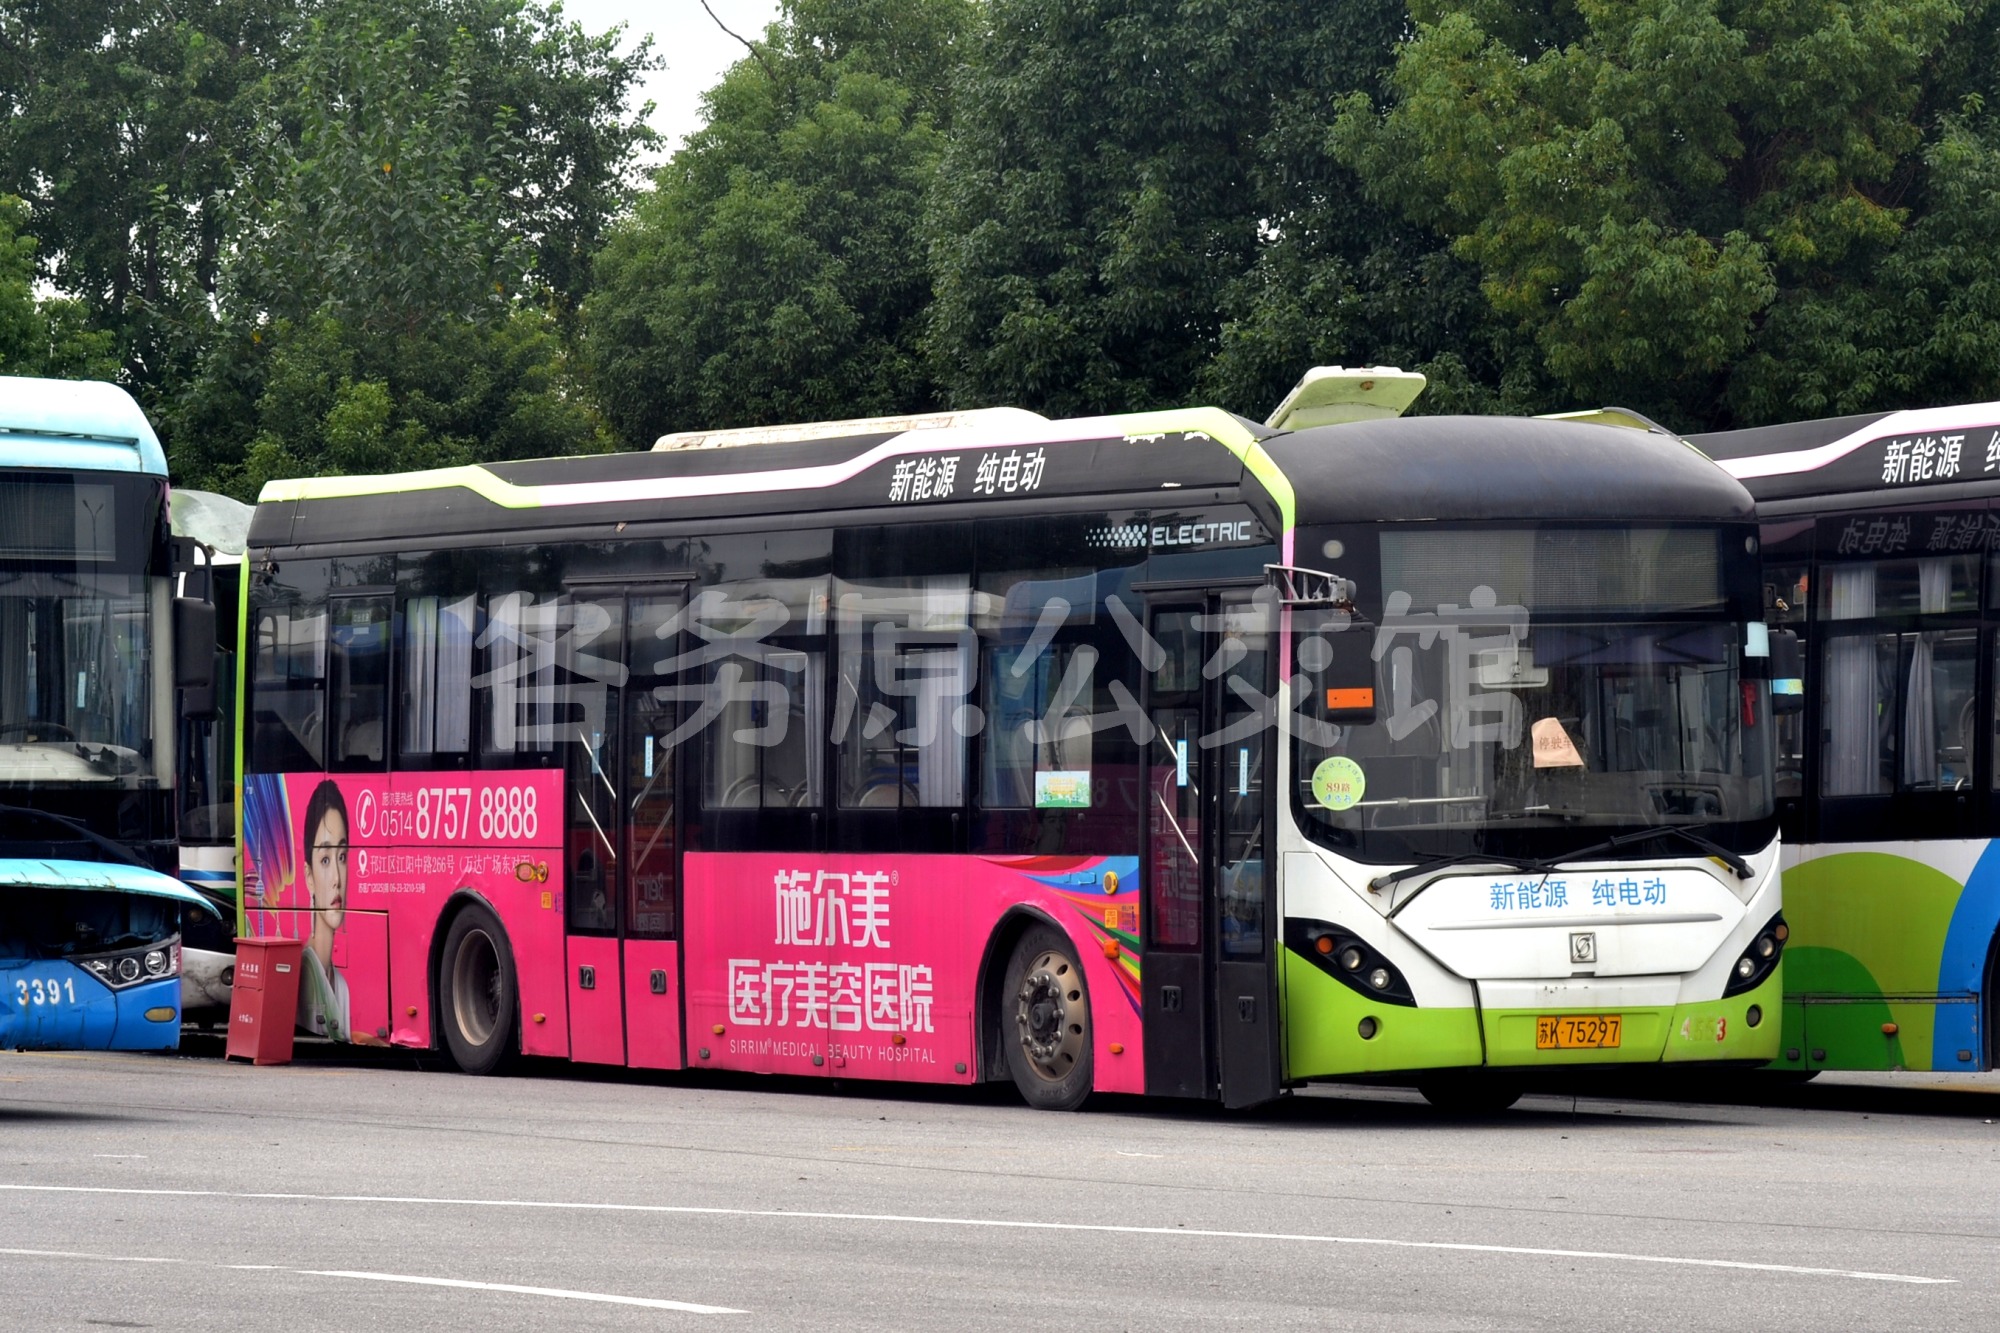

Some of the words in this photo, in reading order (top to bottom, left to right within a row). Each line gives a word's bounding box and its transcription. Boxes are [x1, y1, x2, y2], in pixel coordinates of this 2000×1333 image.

[889, 456, 960, 501] 新能源
[973, 447, 1046, 494] 纯电动
[1882, 435, 1965, 483] 新能源
[1152, 521, 1251, 546] ELECTRIC
[380, 810, 413, 836] 0514
[416, 787, 471, 839] 8757
[479, 786, 538, 839] 8888
[1490, 881, 1568, 909] 新能源
[1592, 878, 1666, 906] 纯电动
[16, 978, 75, 1006] 3391
[728, 958, 934, 1033] 医疗美容医院
[773, 1042, 821, 1057] MEDICAL
[828, 1044, 873, 1060] BEAUTY
[878, 1048, 936, 1064] HOSPITAL
